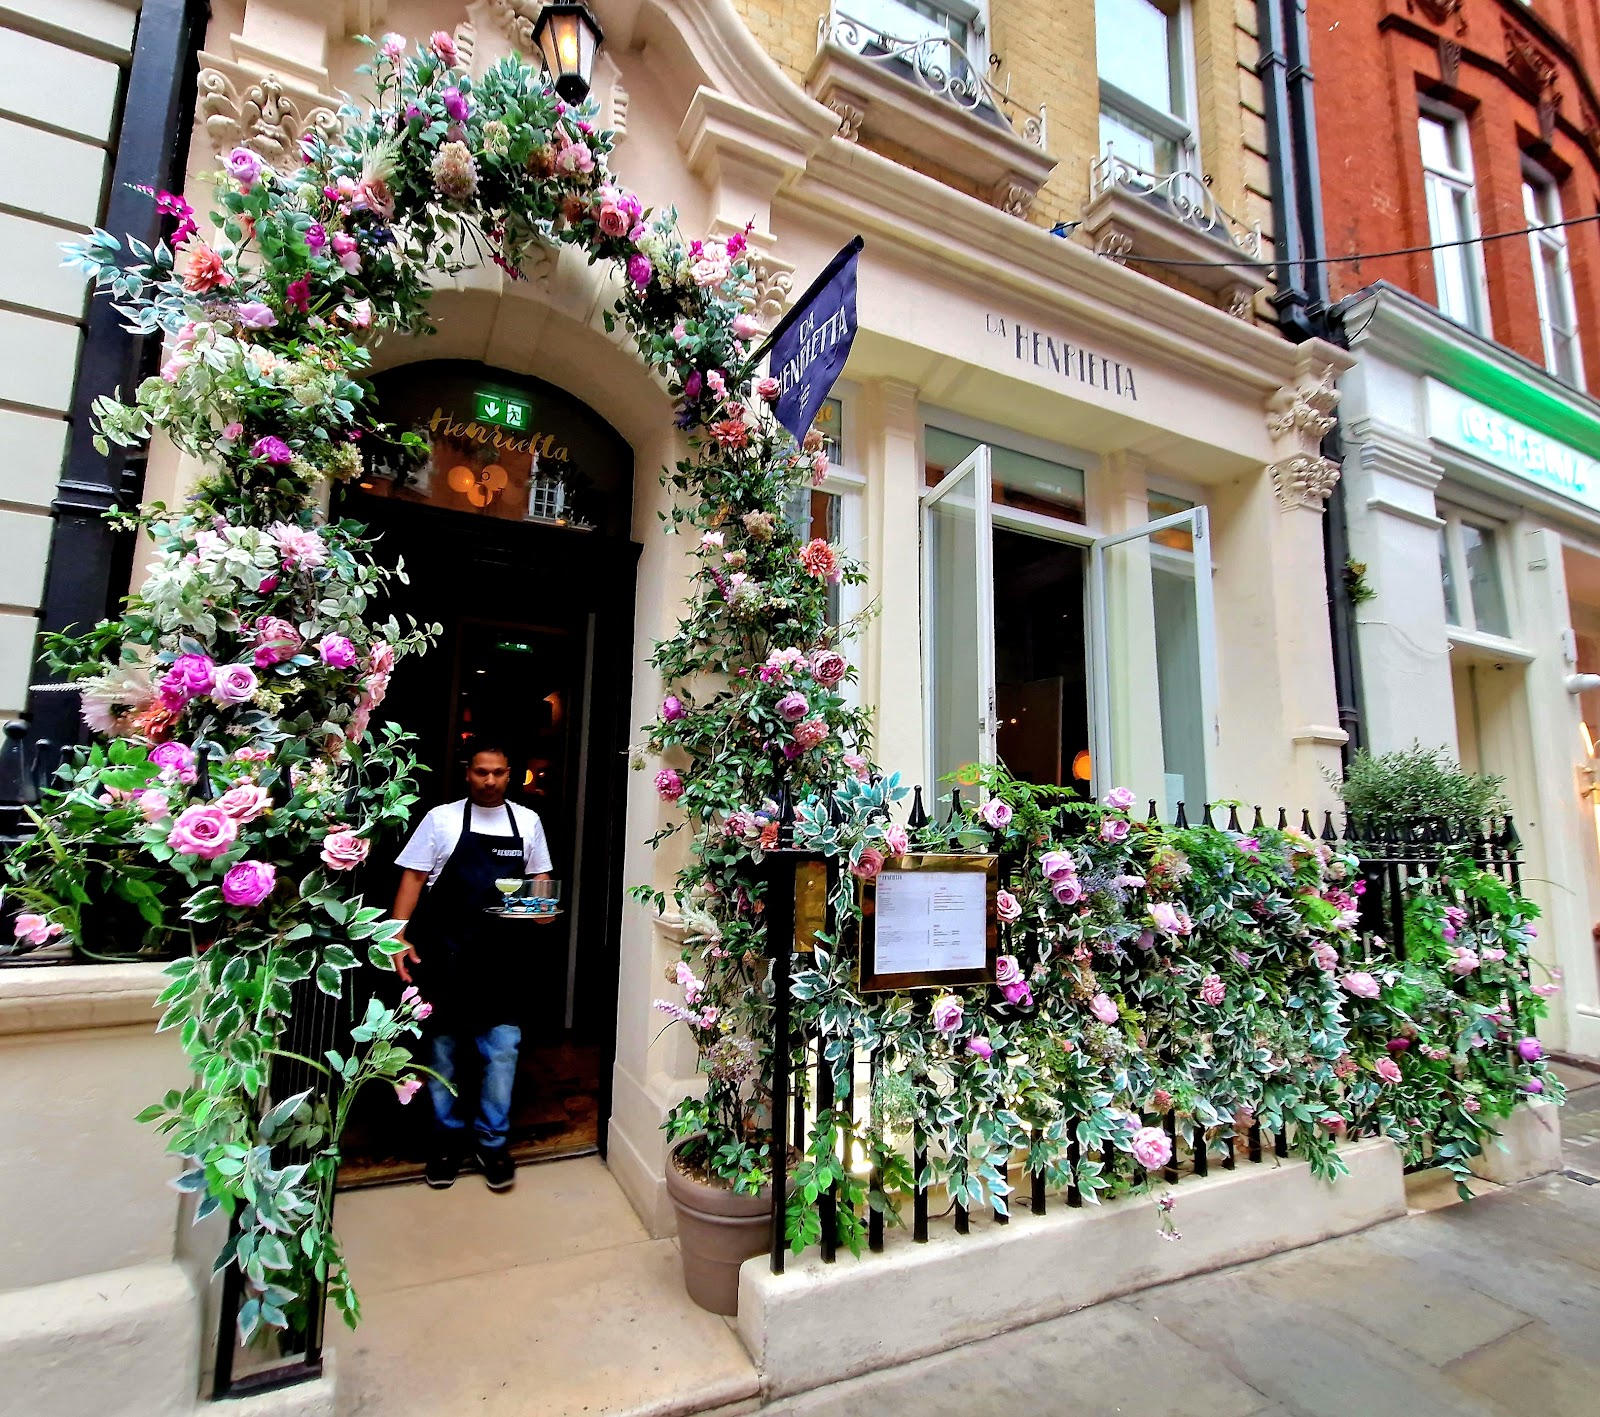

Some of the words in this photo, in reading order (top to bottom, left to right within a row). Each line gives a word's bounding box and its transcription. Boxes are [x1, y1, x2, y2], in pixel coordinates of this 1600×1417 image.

[776, 304, 849, 398] HENRIETTA
[800, 310, 814, 345] DA
[1015, 324, 1137, 401] HENRIETTA
[428, 406, 570, 463] Henrietta
